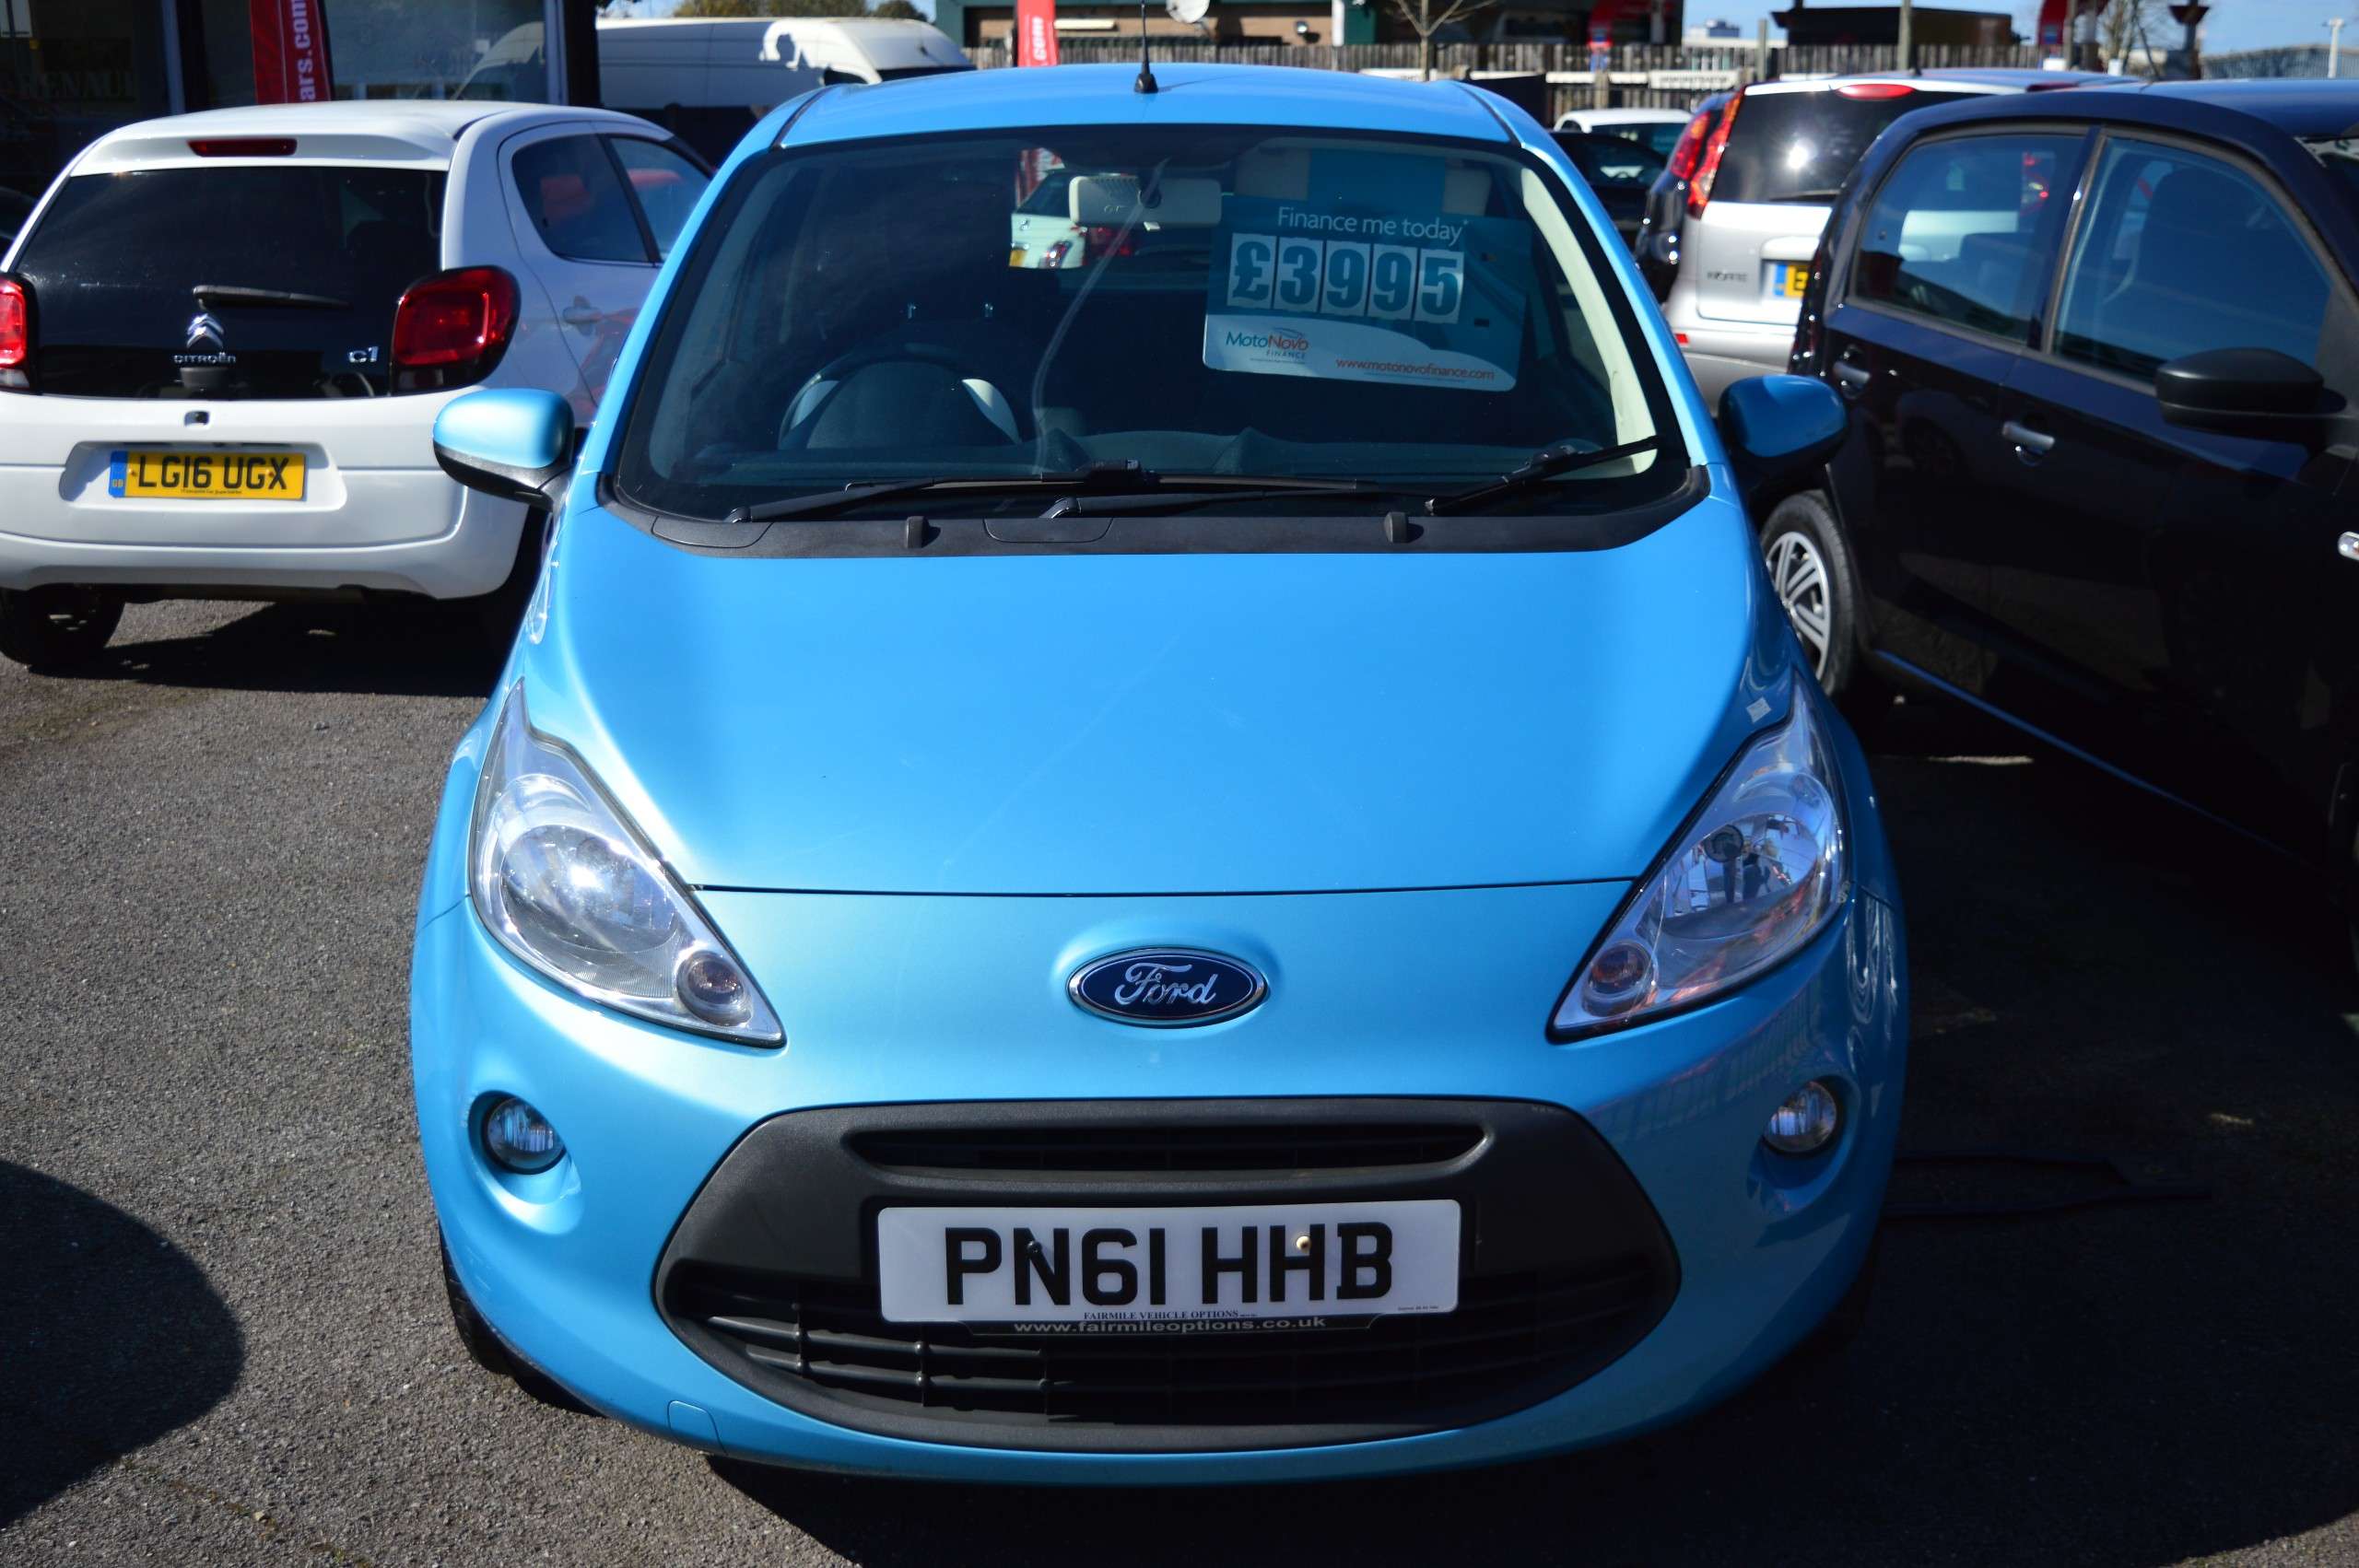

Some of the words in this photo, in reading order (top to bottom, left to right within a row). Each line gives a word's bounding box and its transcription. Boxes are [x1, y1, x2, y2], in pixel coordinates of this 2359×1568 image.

[1277, 205, 1357, 231] Finance
[1362, 216, 1397, 235] me
[1232, 240, 1459, 316] £3995
[1225, 331, 1309, 351] MotoNovo
[1336, 358, 1495, 380] www.motonovofinance.com
[138, 455, 213, 488] LG16
[223, 456, 289, 490] UGX
[1114, 962, 1218, 1005] Ford
[945, 1227, 1166, 1305] PN61
[1202, 1222, 1392, 1305] HHB
[1015, 1316, 1327, 1334] www.fairmileoptions.co.uk
[1084, 1312, 1136, 1320] FAIRMILE
[1140, 1311, 1189, 1320] VEHICLE
[1191, 1309, 1238, 1319] OPTIONS
